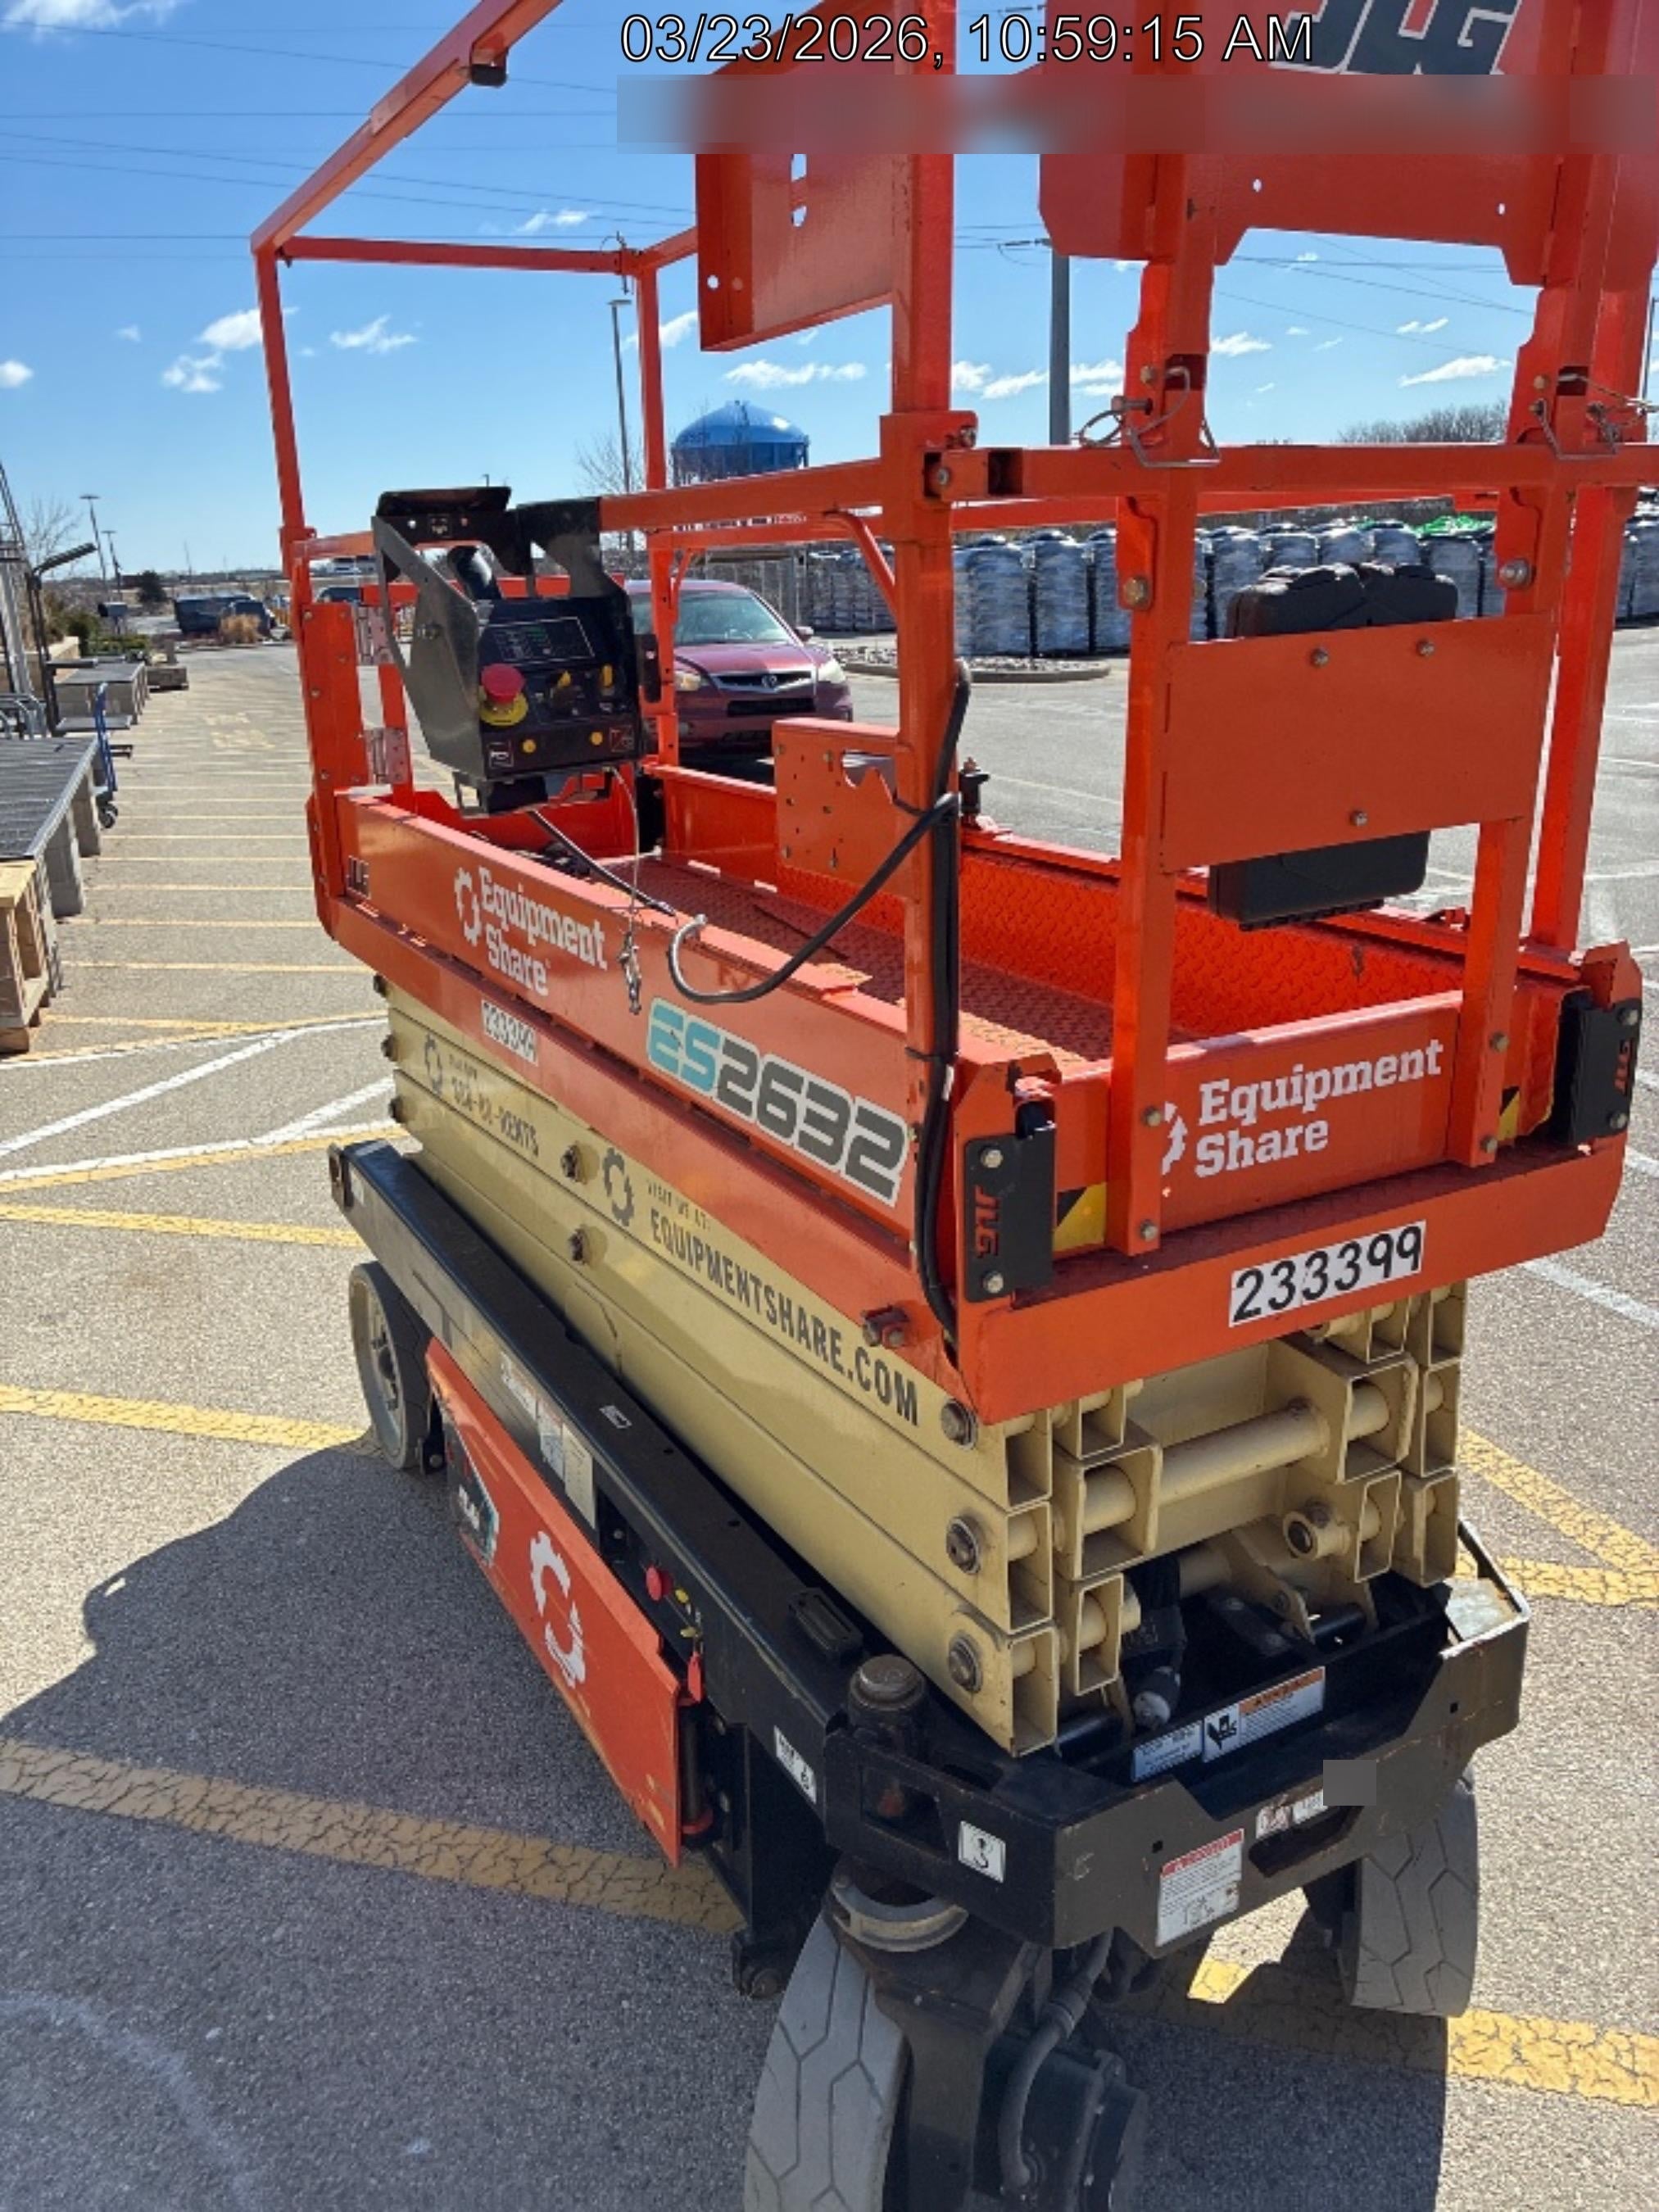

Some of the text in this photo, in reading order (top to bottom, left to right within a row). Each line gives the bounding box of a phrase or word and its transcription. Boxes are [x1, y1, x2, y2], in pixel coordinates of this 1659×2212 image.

[478, 865, 608, 972] Equipment
[485, 922, 549, 997] Share
[647, 997, 909, 1208] ES2632
[1199, 1039, 1444, 1126] Equipment
[1194, 1120, 1329, 1178] Share
[974, 1185, 1001, 1259] JLG
[650, 1207, 918, 1426] EQUIPMENTSHARE.COM
[1232, 1225, 1422, 1323] 233399
